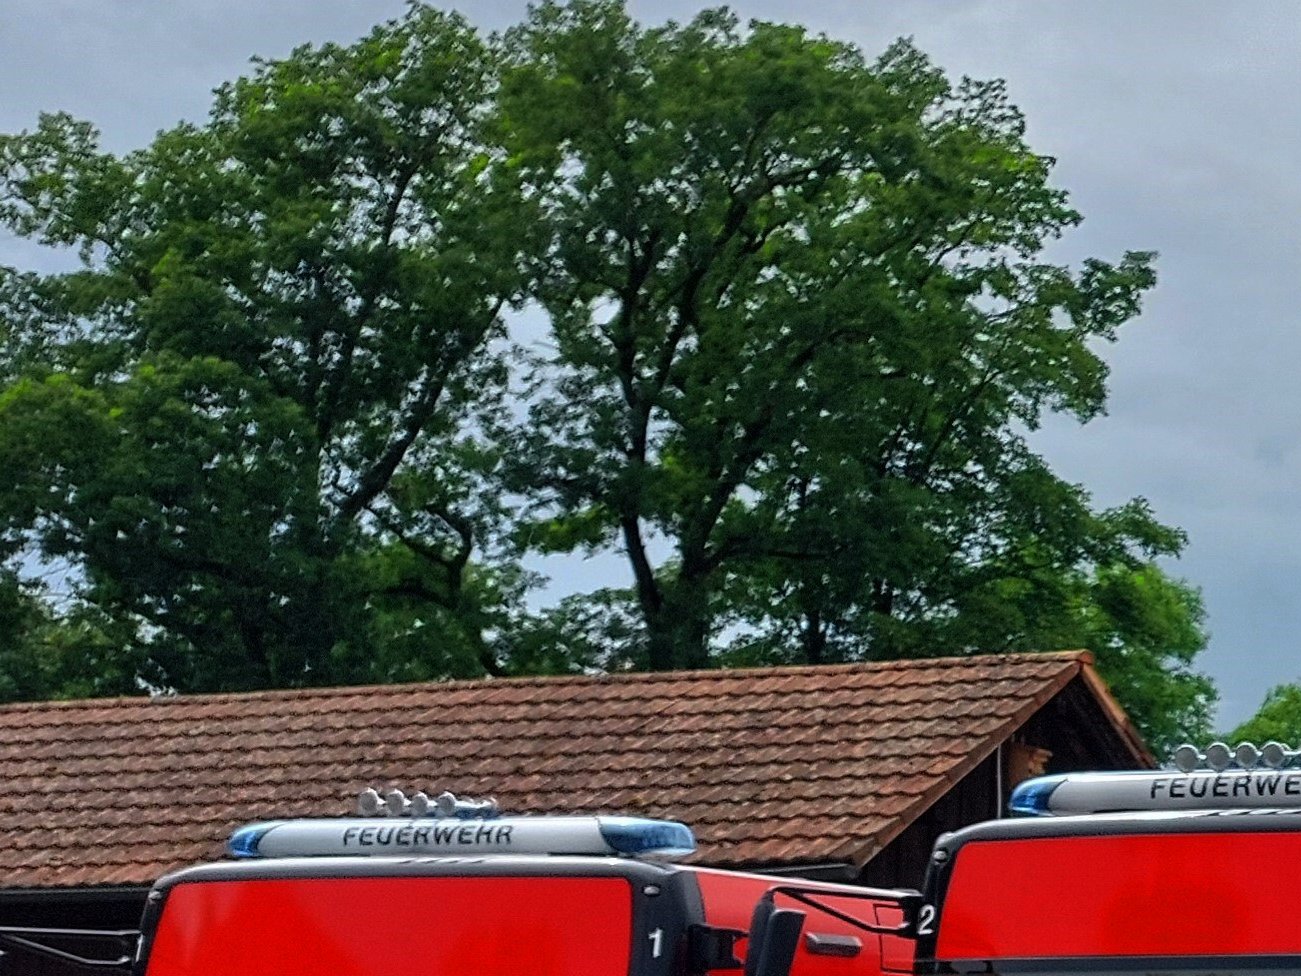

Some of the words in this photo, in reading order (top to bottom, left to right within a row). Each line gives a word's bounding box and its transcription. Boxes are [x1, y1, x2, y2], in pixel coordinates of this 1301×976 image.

[343, 824, 513, 847] FEUERWEHR
[917, 904, 935, 935] 2
[648, 927, 663, 958] 1
